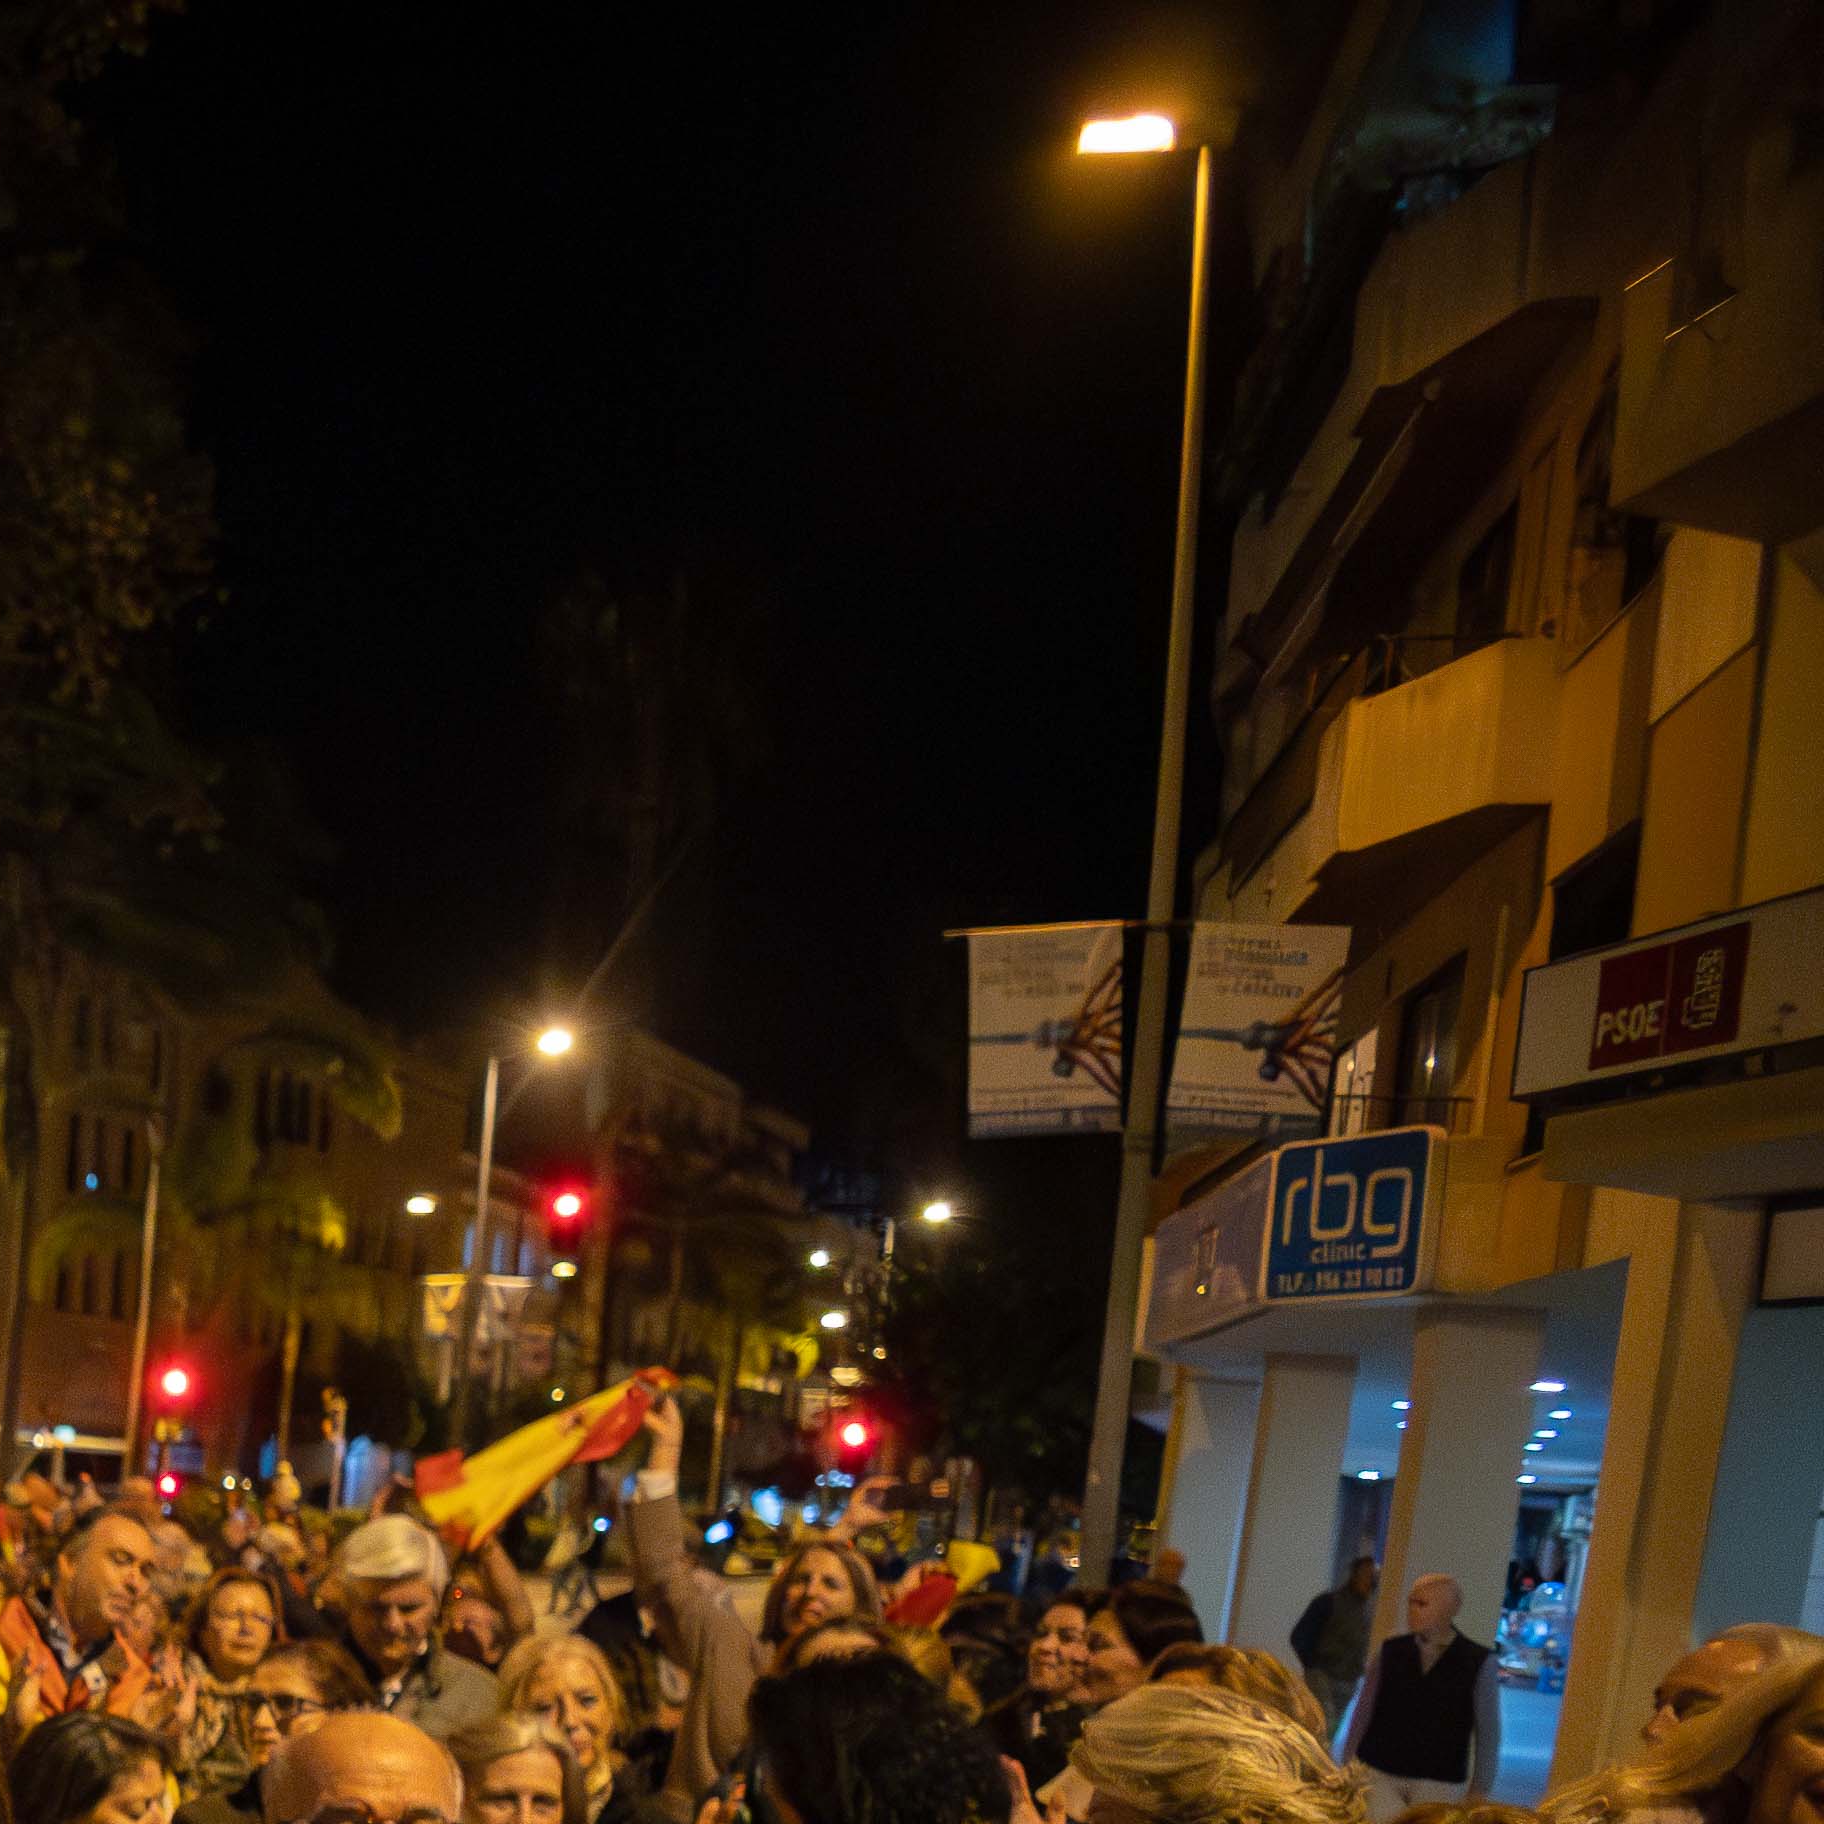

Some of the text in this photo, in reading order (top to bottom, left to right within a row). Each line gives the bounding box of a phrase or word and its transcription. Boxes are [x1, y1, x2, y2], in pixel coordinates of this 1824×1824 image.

[1595, 1001, 1664, 1048] PSOE
[1282, 1149, 1413, 1259] rbg
[1311, 1241, 1366, 1264] clinic
